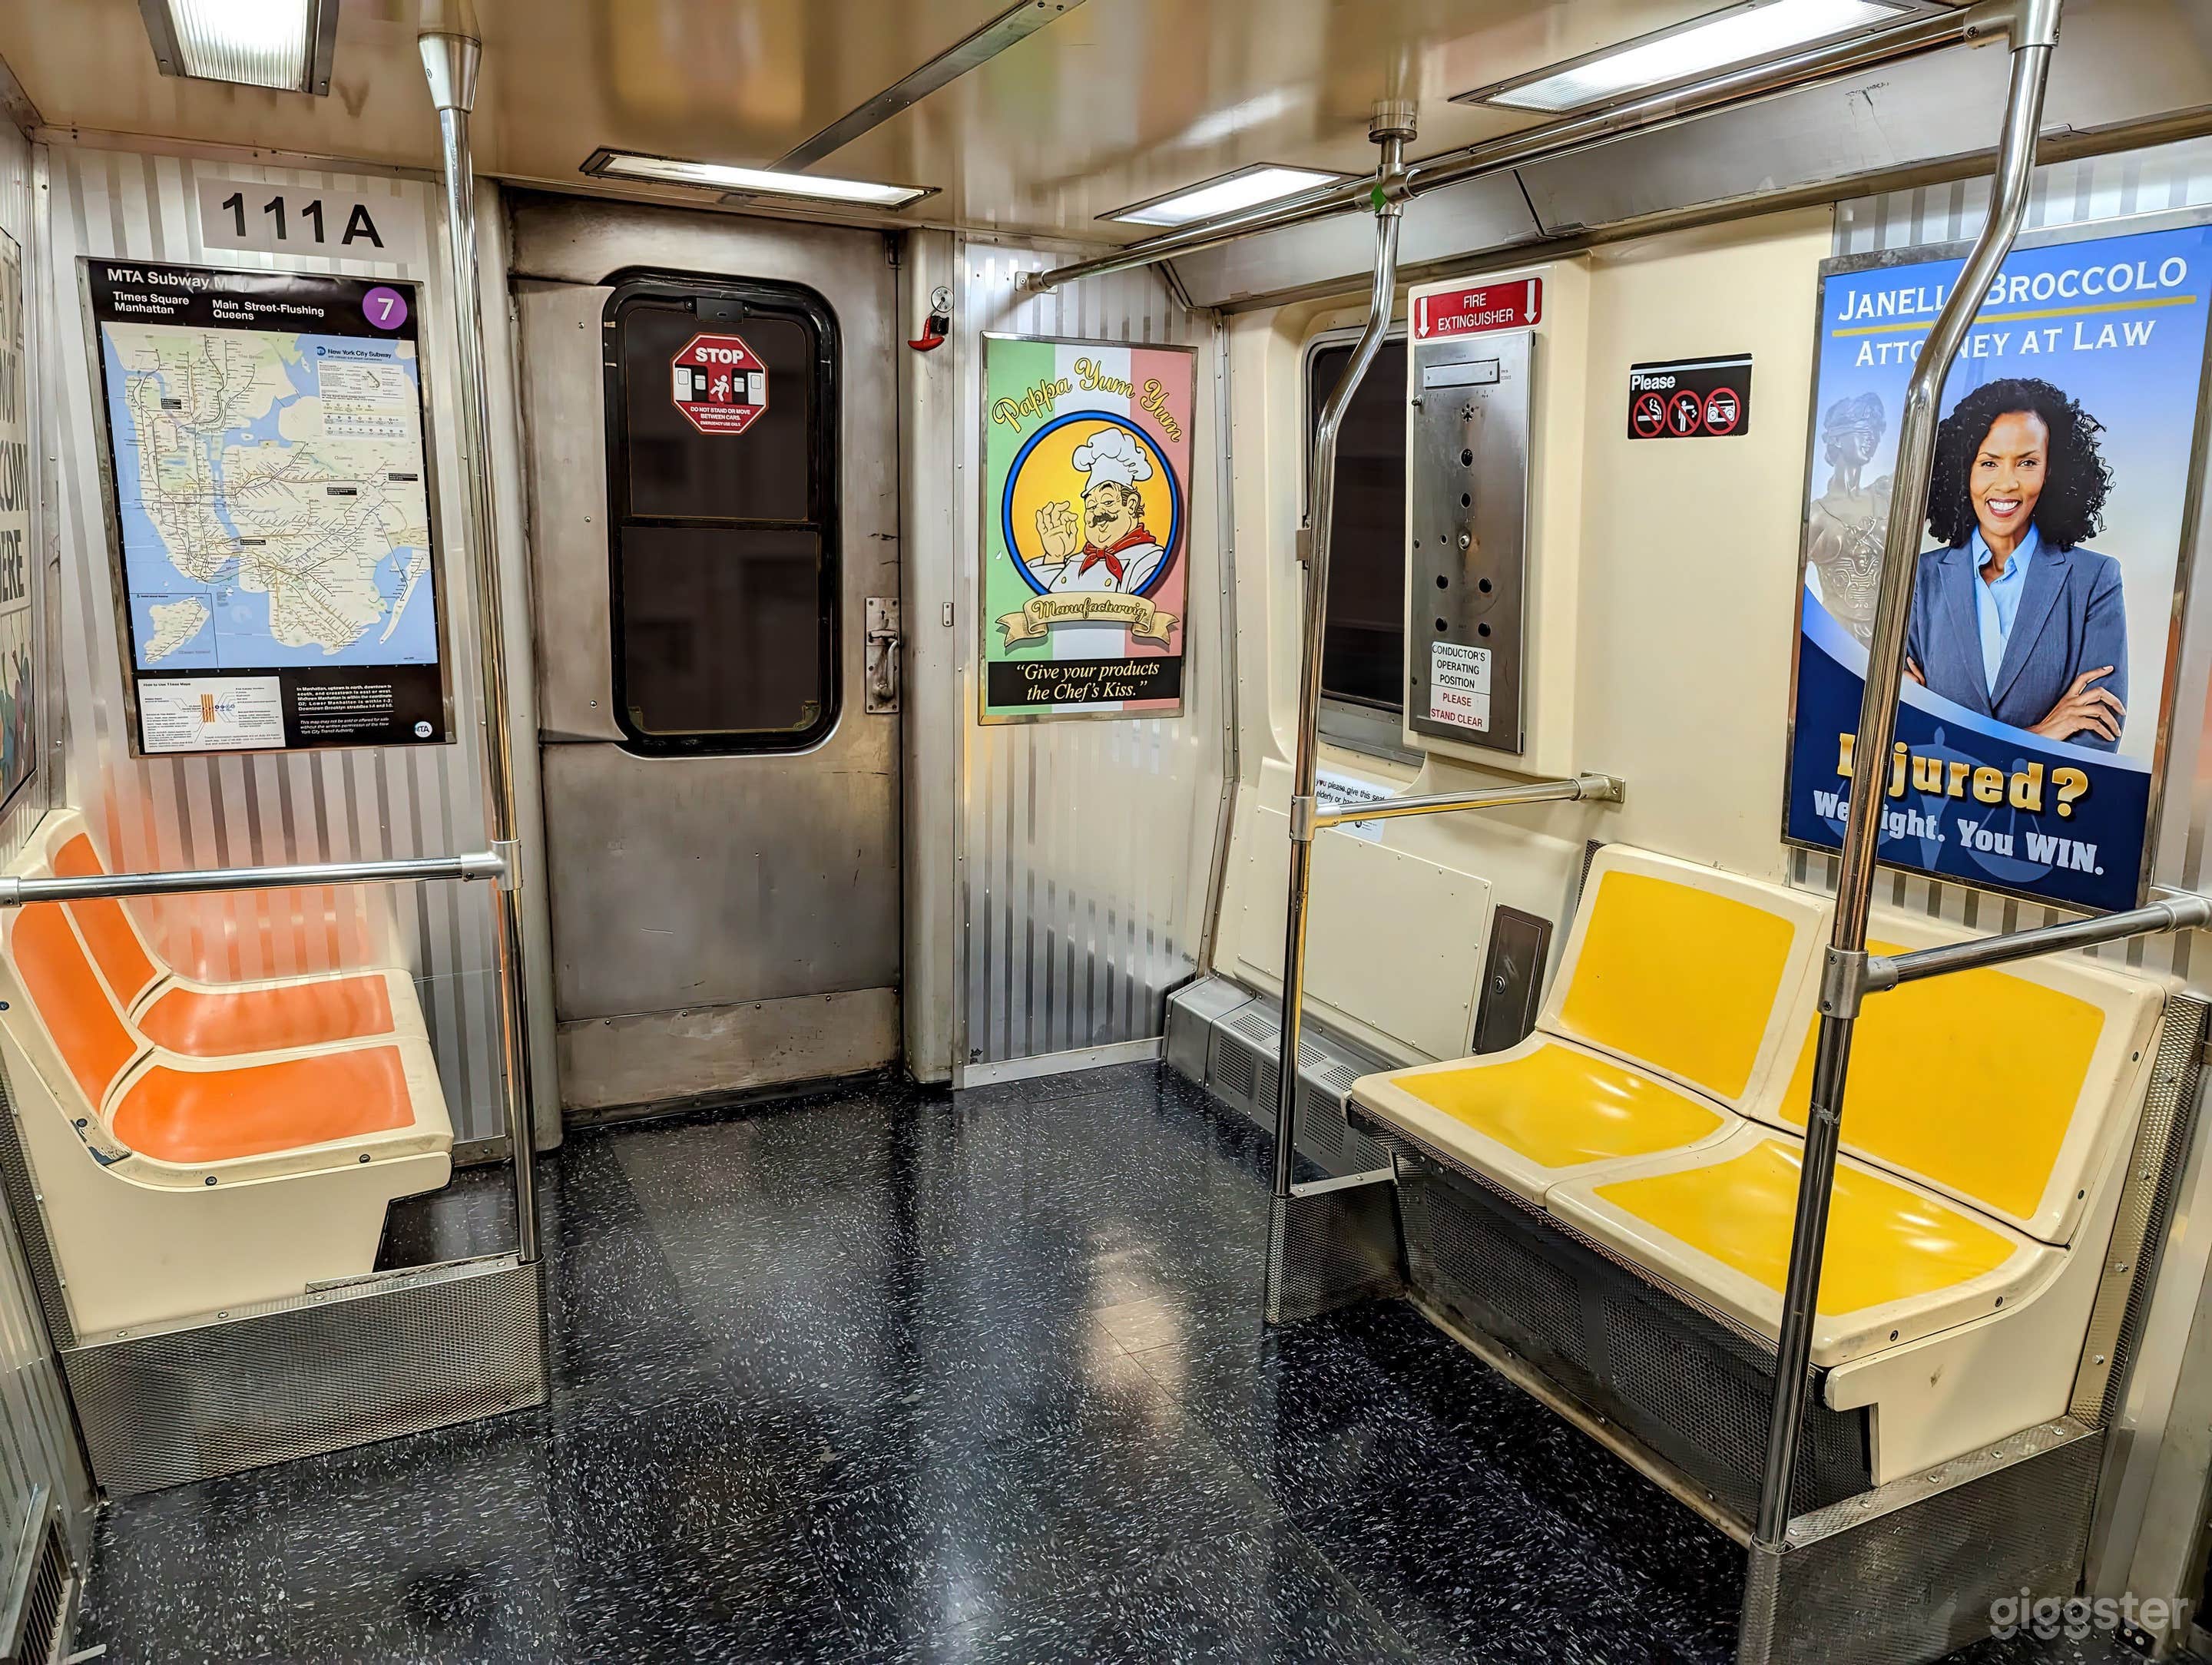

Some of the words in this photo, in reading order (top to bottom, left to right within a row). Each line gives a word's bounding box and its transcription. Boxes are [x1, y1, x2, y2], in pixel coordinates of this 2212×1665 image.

[223, 193, 384, 248] 111A
[107, 269, 144, 283] MTA
[147, 272, 209, 290] Subway
[1838, 285, 1945, 321] JANELL
[1983, 257, 2187, 306] BROCCOLO
[113, 291, 147, 302] Times
[151, 293, 189, 305] Square
[1463, 293, 1487, 309] FIRE
[114, 302, 174, 314] Manhattan
[212, 300, 238, 309] Main
[244, 302, 324, 317] Street-Flushing
[214, 309, 254, 320] Queens
[377, 297, 394, 321] 7
[1438, 308, 1514, 331] EXTINGUISHER
[1855, 333, 2011, 367] ATTONEY
[2018, 327, 2062, 355] AT
[2073, 319, 2156, 351] LAW
[695, 347, 744, 364] STOP
[1631, 375, 1676, 391] Please
[992, 378, 1072, 433] Pappa
[1075, 357, 1135, 399] Yum
[1141, 379, 1182, 442] Yum
[1031, 597, 1147, 622] Manufacturing
[1432, 645, 1485, 661] CONDUCTOR'S
[1062, 667, 1097, 683] your
[1098, 661, 1159, 680] products
[1437, 660, 1479, 675] OPERATING
[1440, 674, 1475, 688] POSITION
[1027, 685, 1050, 700] the
[1442, 693, 1472, 707] PLEASE
[1431, 708, 1455, 721] STAND
[1457, 714, 1482, 727] CLEAR
[1836, 732, 2089, 818] Ijured?
[1316, 790, 1334, 803] elderly
[1327, 781, 1346, 792] please
[1346, 786, 1359, 796] give
[1360, 790, 1370, 799] this
[1813, 790, 1849, 822] We
[1881, 804, 1945, 842] ight.
[1958, 818, 2014, 856] You
[2026, 831, 2104, 876] WIN.
